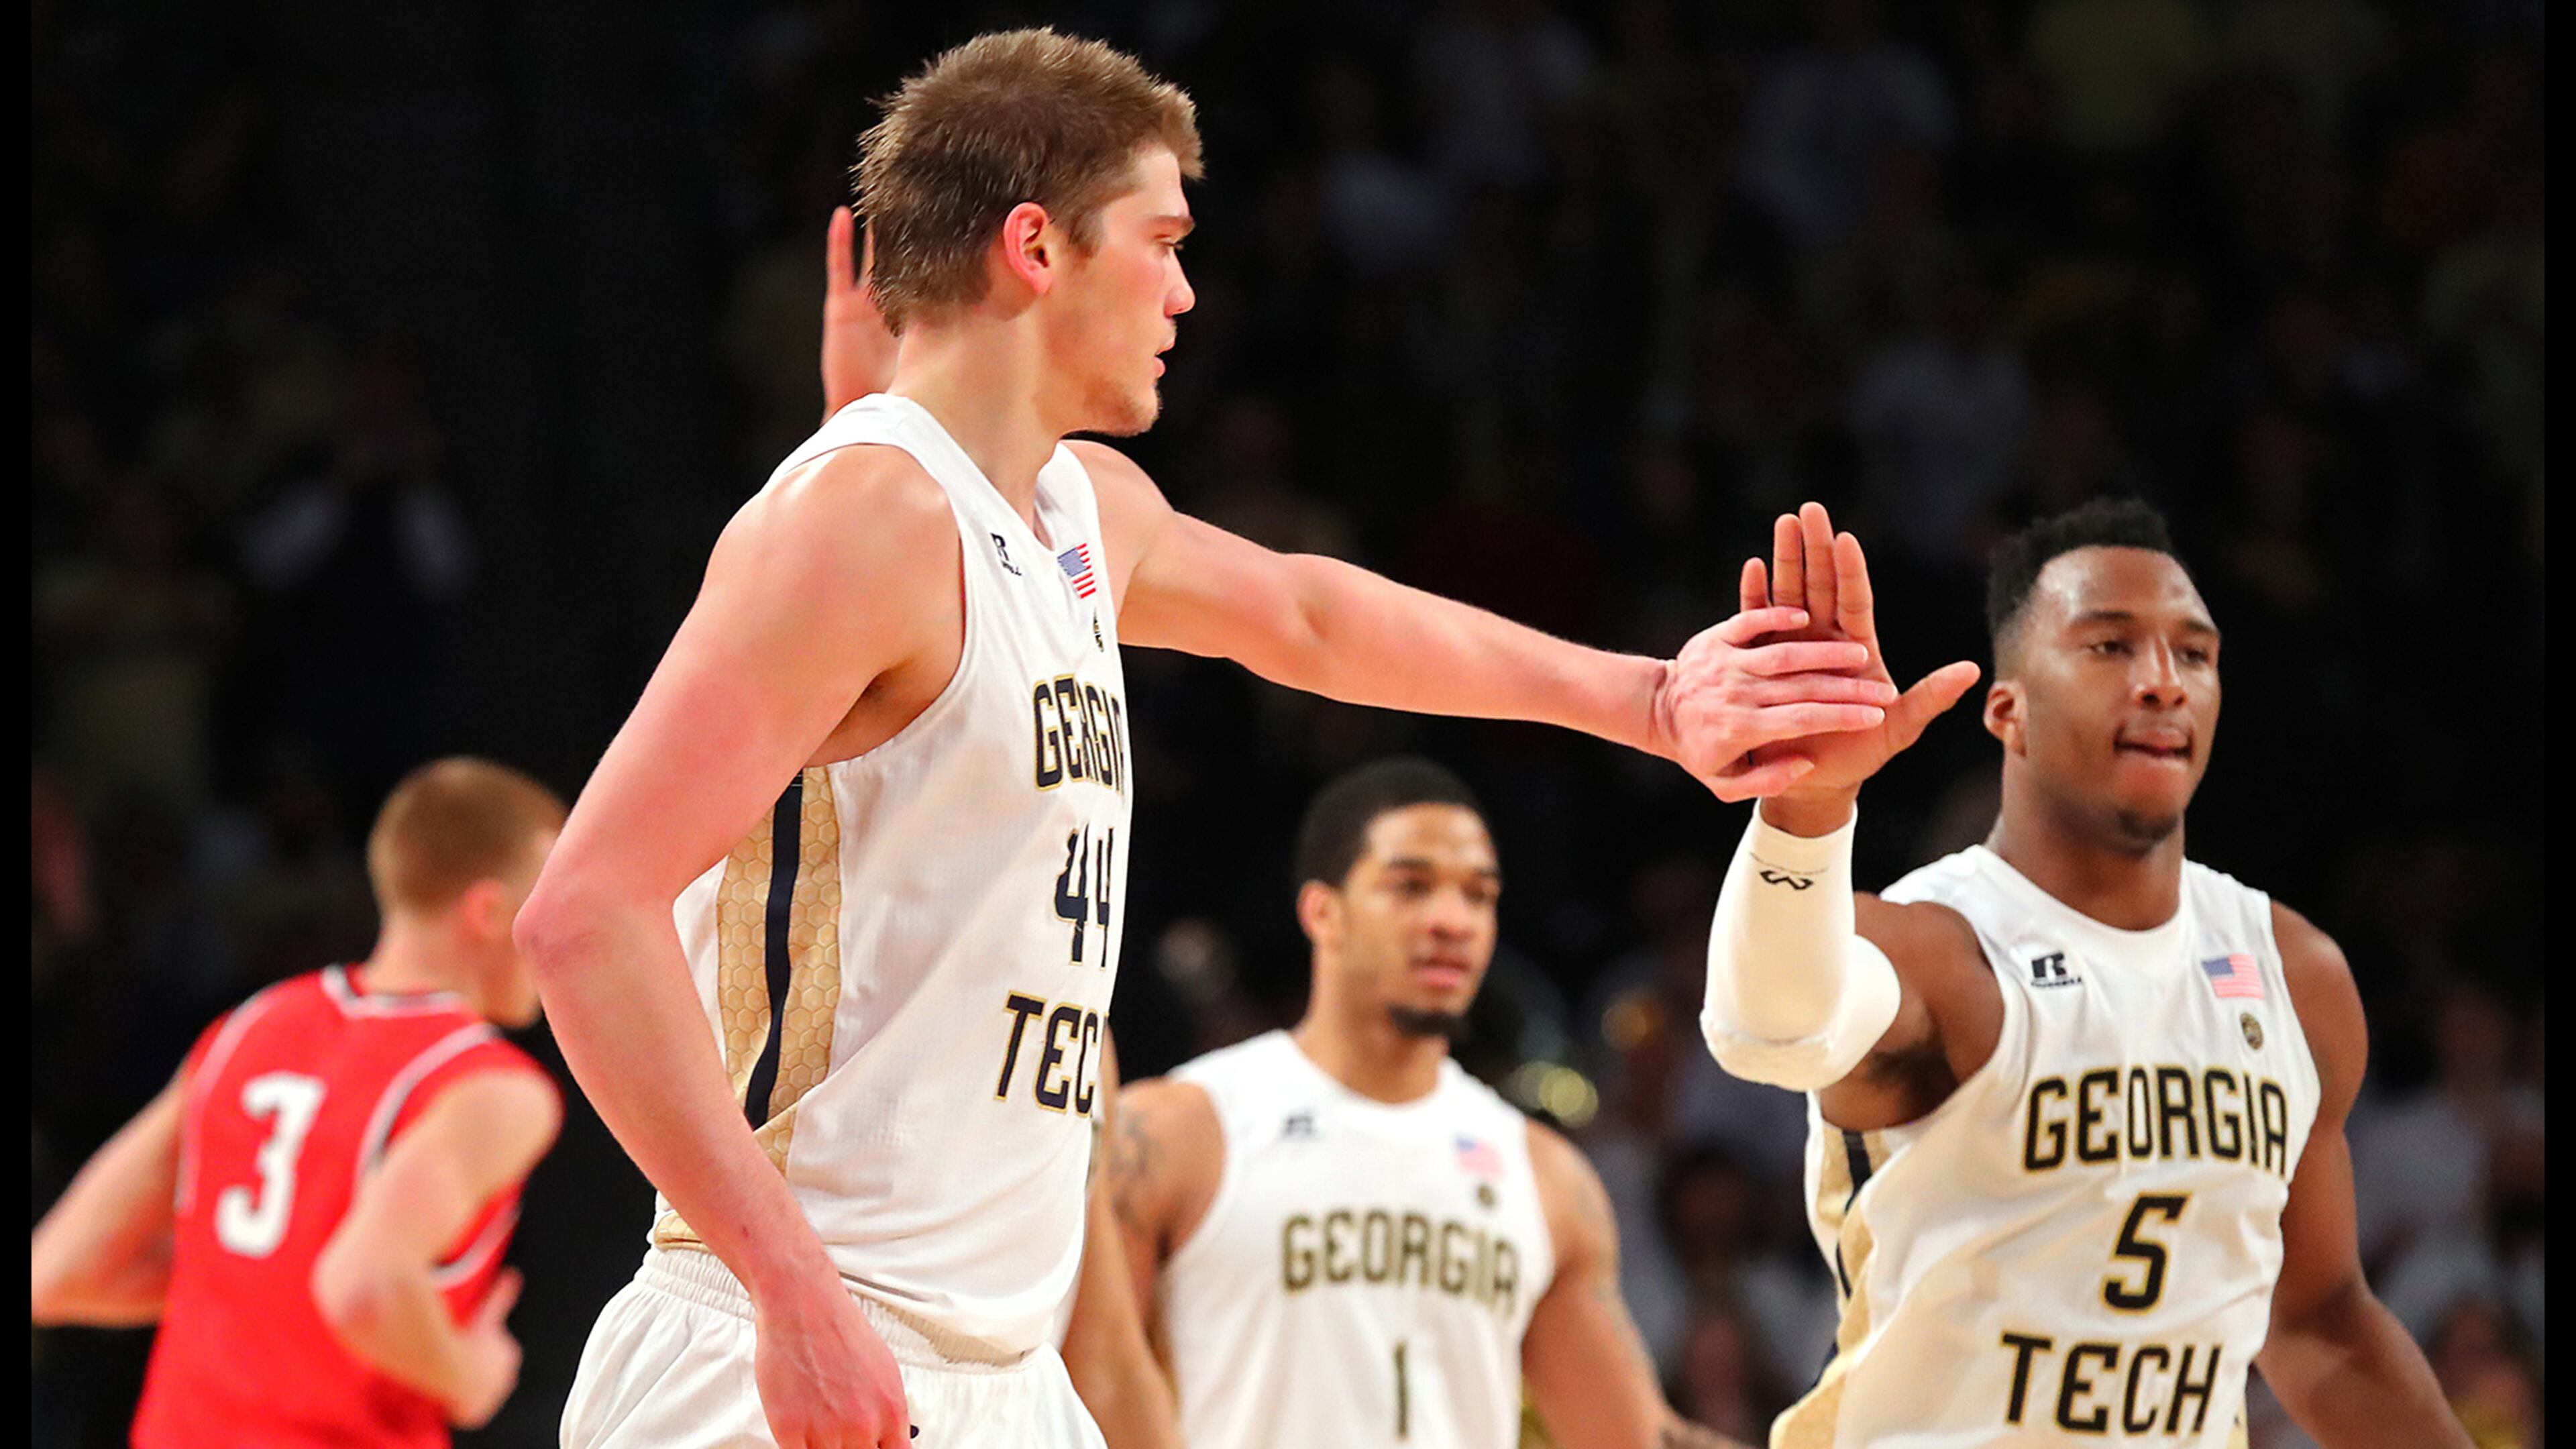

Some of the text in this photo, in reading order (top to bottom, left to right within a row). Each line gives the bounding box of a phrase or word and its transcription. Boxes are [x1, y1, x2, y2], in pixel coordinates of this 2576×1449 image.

[1034, 673, 1125, 796] GERGI
[1054, 823, 1114, 971] 44
[994, 989, 1109, 1118] TEC
[215, 1071, 328, 1258] 3
[2023, 1065, 2288, 1179] GEORGIA
[1283, 1207, 1520, 1319] GEORGIA
[2100, 1191, 2193, 1315] 5
[1393, 1340, 1410, 1442] 1
[2000, 1330, 2223, 1438] TECH
